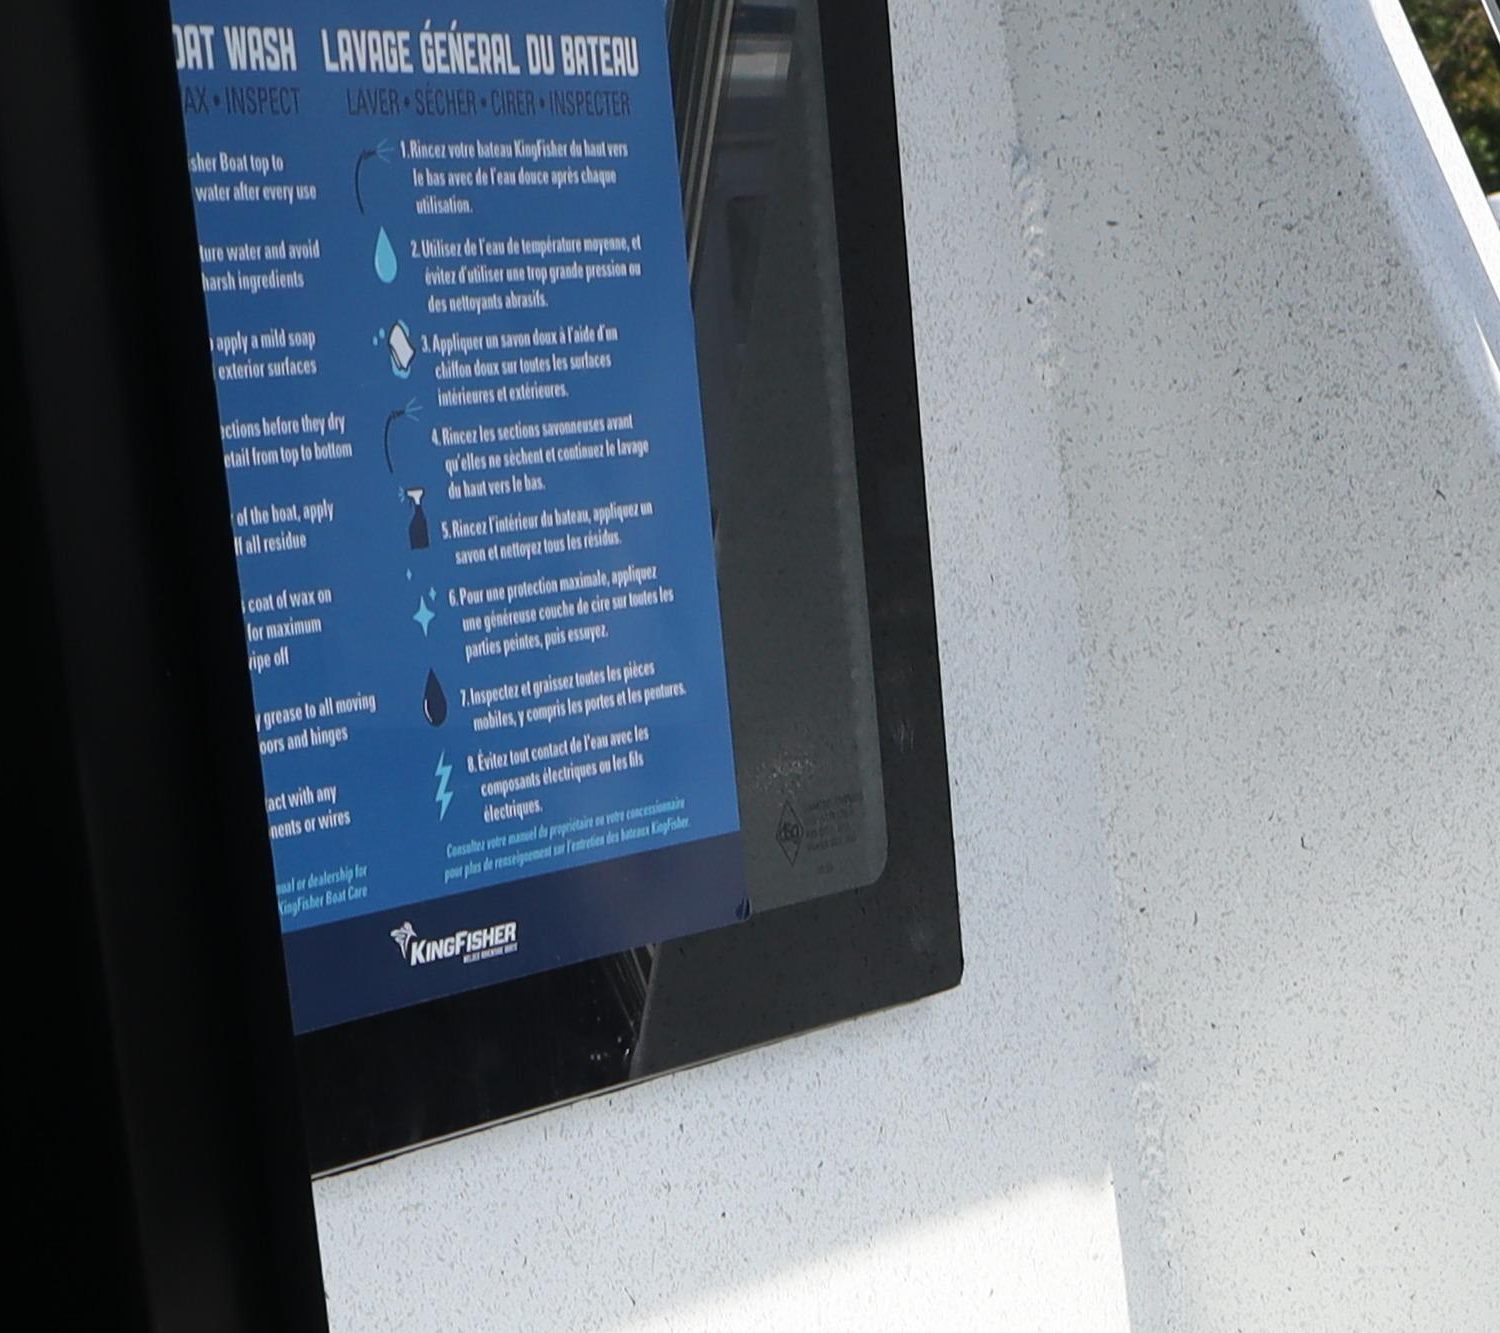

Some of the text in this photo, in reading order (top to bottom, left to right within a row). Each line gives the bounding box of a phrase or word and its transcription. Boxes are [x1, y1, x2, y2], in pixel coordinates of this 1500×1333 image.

[223, 26, 296, 71] WASH
[321, 28, 413, 72] LAVAGE
[526, 33, 554, 74] DU
[560, 34, 638, 76] BATEAU
[180, 85, 302, 114] AX INSPECT
[346, 82, 630, 115] LAVER SÉCHER CIRER INSPECTER
[447, 141, 474, 157] votre
[476, 139, 512, 157] bateau
[513, 139, 566, 159] KingFisher
[569, 139, 582, 156] du
[583, 138, 605, 156] haut
[606, 143, 627, 156] vers
[219, 151, 247, 171] Boat
[250, 154, 269, 175] top
[271, 154, 283, 171] to
[412, 166, 616, 188] le bas avec de l'eau douce après chaque
[194, 181, 316, 204] water after every use
[416, 195, 472, 213] utilisation.
[226, 243, 261, 260] water
[264, 240, 285, 259] and
[288, 238, 319, 258] avoid
[201, 270, 304, 293] harsh ingredients
[428, 289, 548, 314] des nettoyants abrasifs.
[216, 328, 315, 355] apply a mild soap
[218, 357, 316, 380] exterior surfaces
[438, 382, 568, 406] intérieures et extérieures.
[262, 415, 299, 435] before
[301, 413, 324, 434] they
[327, 411, 344, 434] dry
[441, 426, 477, 445] Rincez
[479, 424, 495, 441] les
[497, 420, 539, 440] sections
[541, 418, 604, 436] savonneuses
[606, 413, 632, 429] avant
[251, 447, 278, 465] from
[280, 446, 298, 466] top
[300, 444, 312, 461] to
[314, 442, 352, 459] bottom
[445, 439, 648, 477] qu'elles ne sèchent et continuez le lavage
[448, 474, 545, 499] du haut vers le bas.
[236, 498, 333, 526] of the boat, apply
[245, 531, 306, 554] all residue
[247, 588, 331, 612] coat of wax on
[246, 617, 321, 641] for maximum
[273, 645, 289, 665] off
[465, 624, 608, 663] parties peintes, puis essuyez.
[263, 691, 375, 730] grease to all moving
[287, 729, 308, 749] and
[310, 726, 347, 746] hinges
[480, 750, 643, 796] composants électriques ou les fils
[287, 785, 313, 807] with
[316, 785, 336, 803] any
[304, 817, 315, 832] or
[317, 809, 350, 829] wires
[483, 799, 542, 822] électriques.
